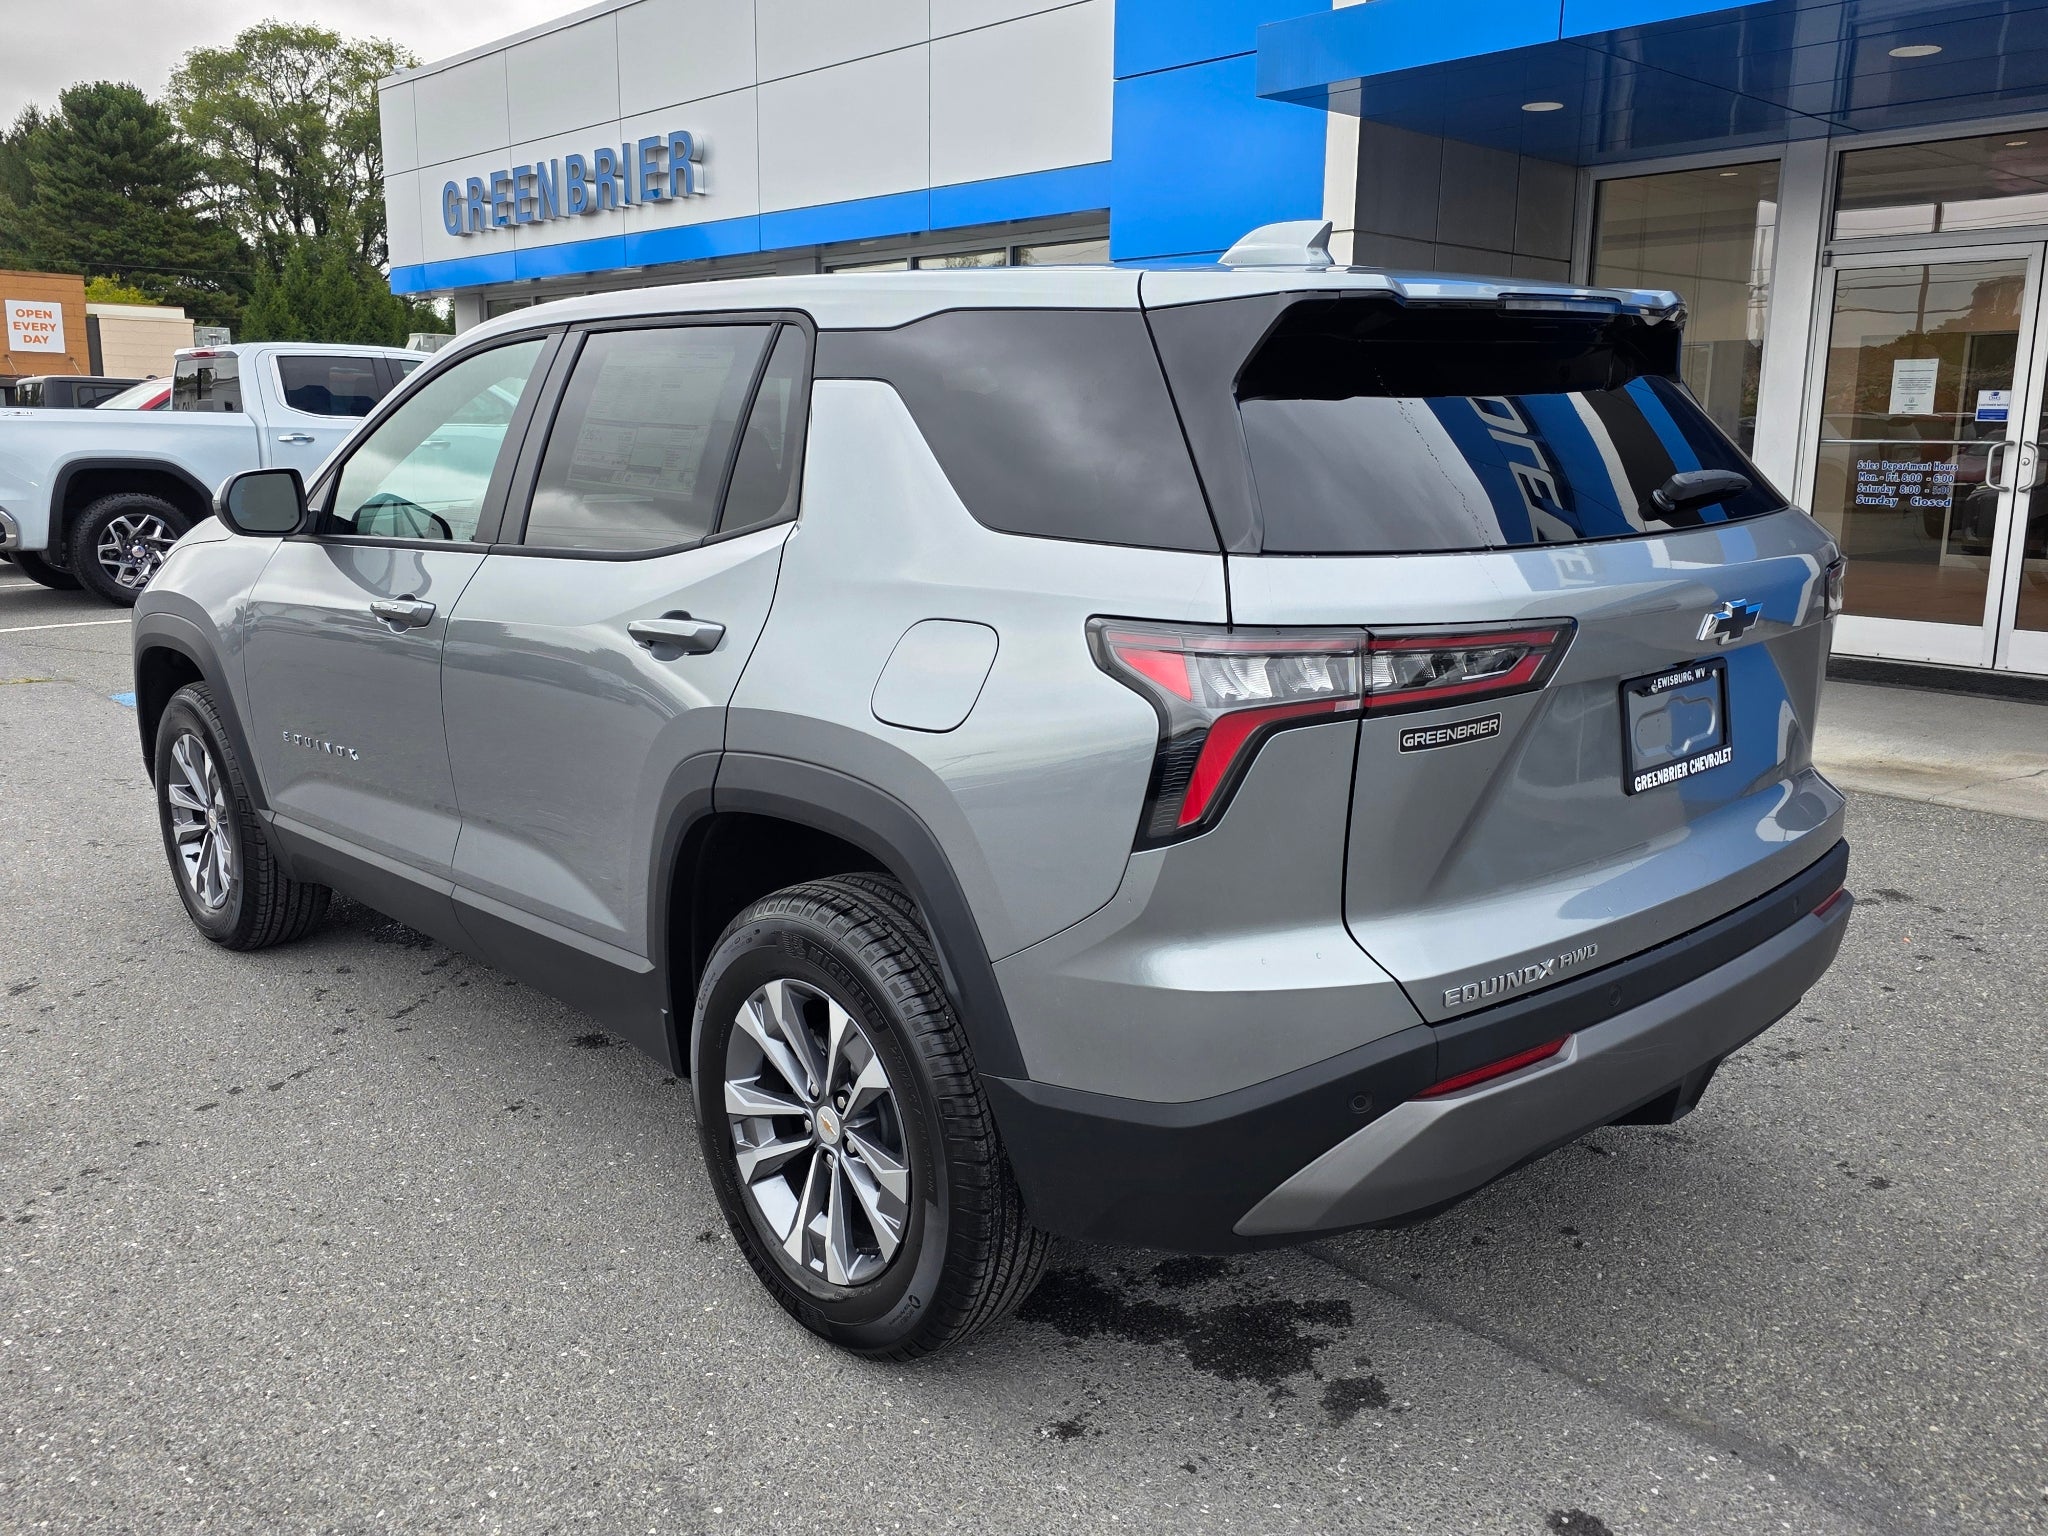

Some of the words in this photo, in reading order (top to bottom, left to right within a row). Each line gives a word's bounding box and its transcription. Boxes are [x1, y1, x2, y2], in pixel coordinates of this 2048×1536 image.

[442, 130, 702, 236] GREENBRIER
[15, 308, 53, 319] OPEN
[13, 321, 57, 332] EVERY
[23, 334, 49, 344] DAY
[1857, 460, 1879, 470] Sales
[1881, 460, 1932, 472] Department
[1933, 461, 1958, 471] Hours
[1858, 472, 1878, 481] Mon.
[1885, 472, 1900, 482] Fri.
[1901, 473, 1922, 482] 8:00
[1933, 474, 1954, 483] 6:00
[1857, 483, 1896, 496] Saturday
[1899, 485, 1920, 494] 8:00
[1856, 494, 1898, 507] Sunday
[1910, 496, 1952, 507] Closed
[1695, 667, 1706, 679] WV
[1402, 719, 1498, 747] GREENBRIER
[283, 731, 359, 760] EQUINOX
[1634, 762, 1688, 792] GREENBRIER
[1690, 747, 1732, 774] CHEVROLET
[1443, 958, 1555, 1008] EQUINOX
[1559, 943, 1598, 969] AWD
[807, 946, 885, 1030] MICHELIN
